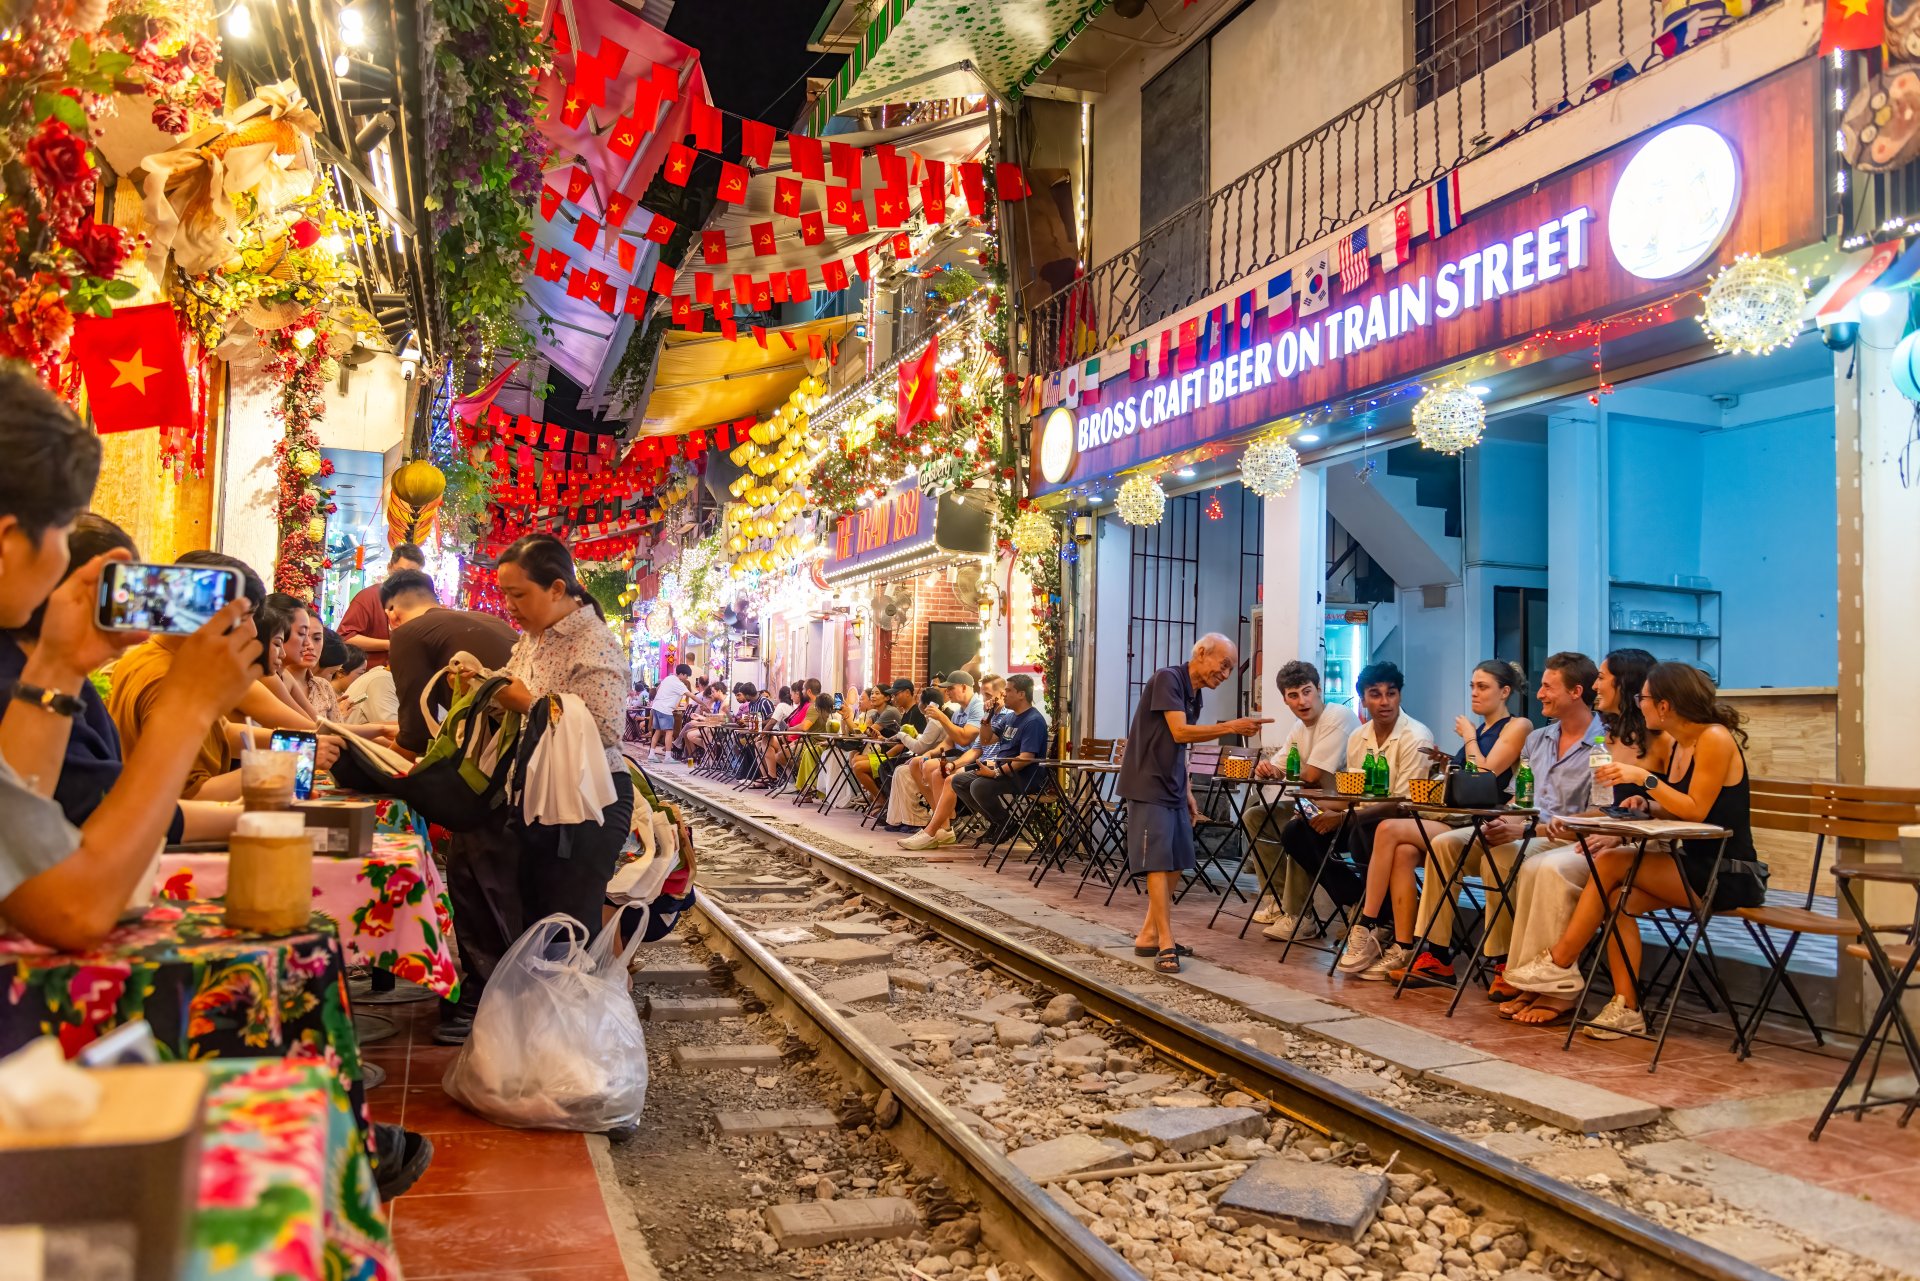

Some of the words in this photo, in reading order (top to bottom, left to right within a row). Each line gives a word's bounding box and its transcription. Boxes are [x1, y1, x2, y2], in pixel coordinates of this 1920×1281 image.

[1078, 396, 1137, 453] BROSS
[1140, 367, 1206, 429] CRAFT
[1209, 342, 1273, 404] BEER
[1276, 320, 1320, 378] ON
[1325, 275, 1426, 360] TRAIN
[1435, 206, 1590, 319] STREET
[836, 514, 855, 562] THE
[857, 500, 891, 554] TRAIN
[893, 486, 920, 542] 1881
